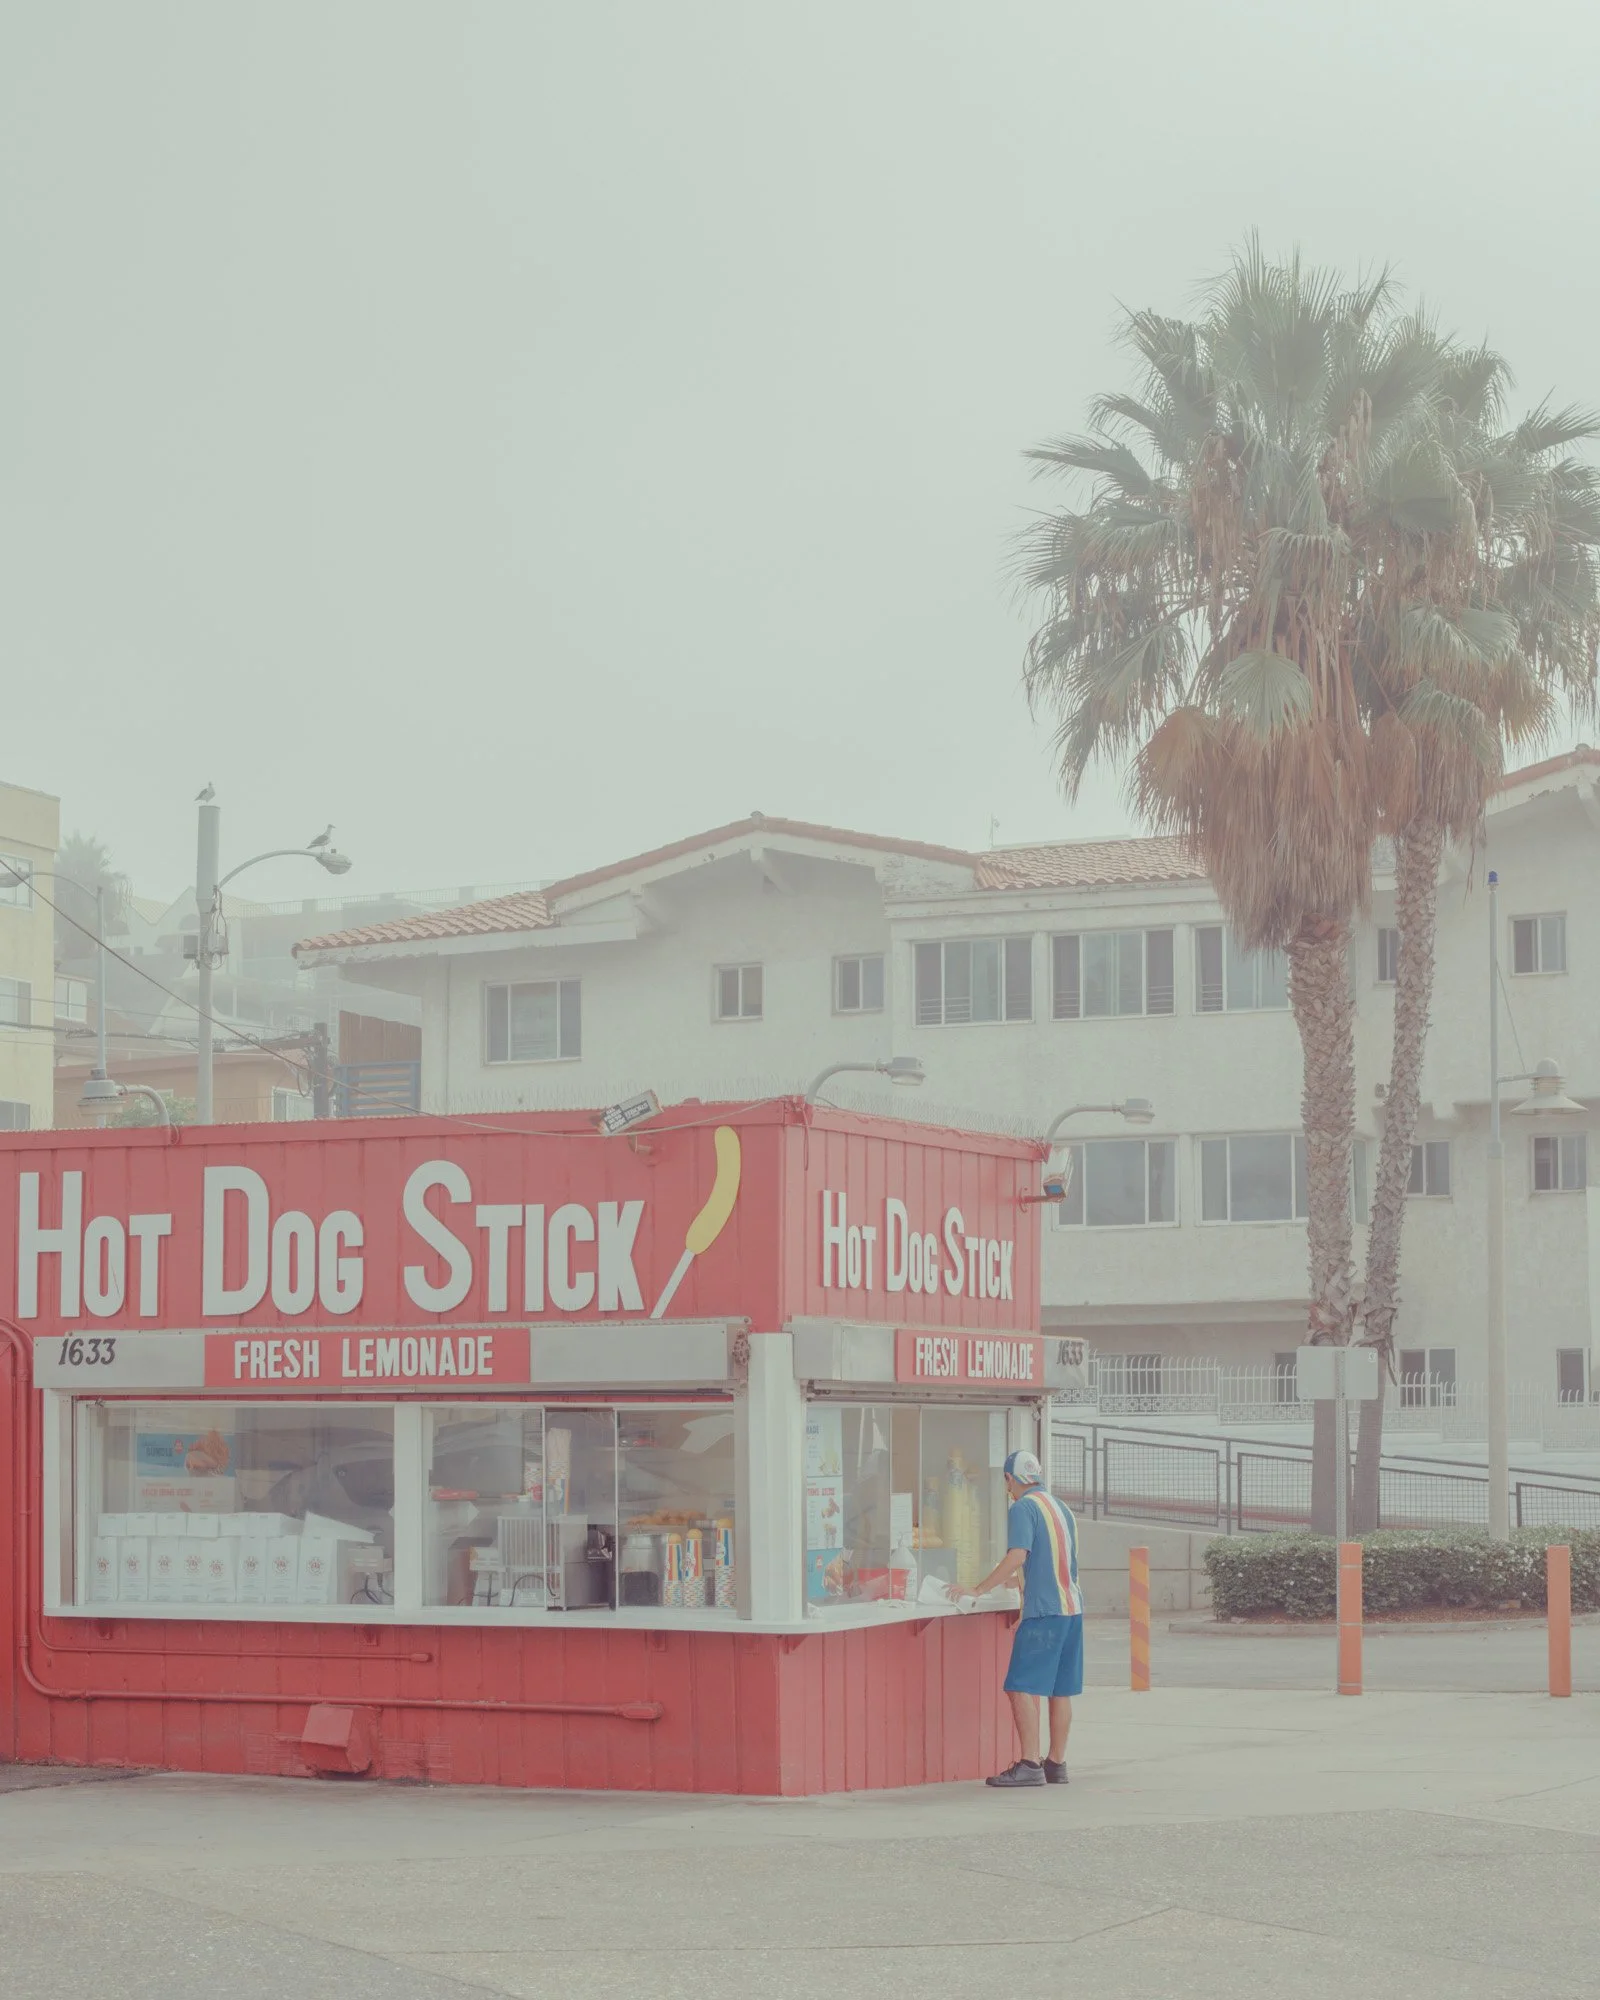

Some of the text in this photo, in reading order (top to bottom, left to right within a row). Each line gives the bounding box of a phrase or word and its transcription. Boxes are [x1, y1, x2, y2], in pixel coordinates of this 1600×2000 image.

[18, 1159, 644, 1319] HOT DOG STICK
[822, 1188, 1014, 1300] HOT DOG STICK
[58, 1336, 116, 1366] 1633
[234, 1335, 493, 1379] FRESH LEMONADE
[915, 1335, 1037, 1382] FRESH LEMONADE
[1056, 1340, 1084, 1366] 1633
